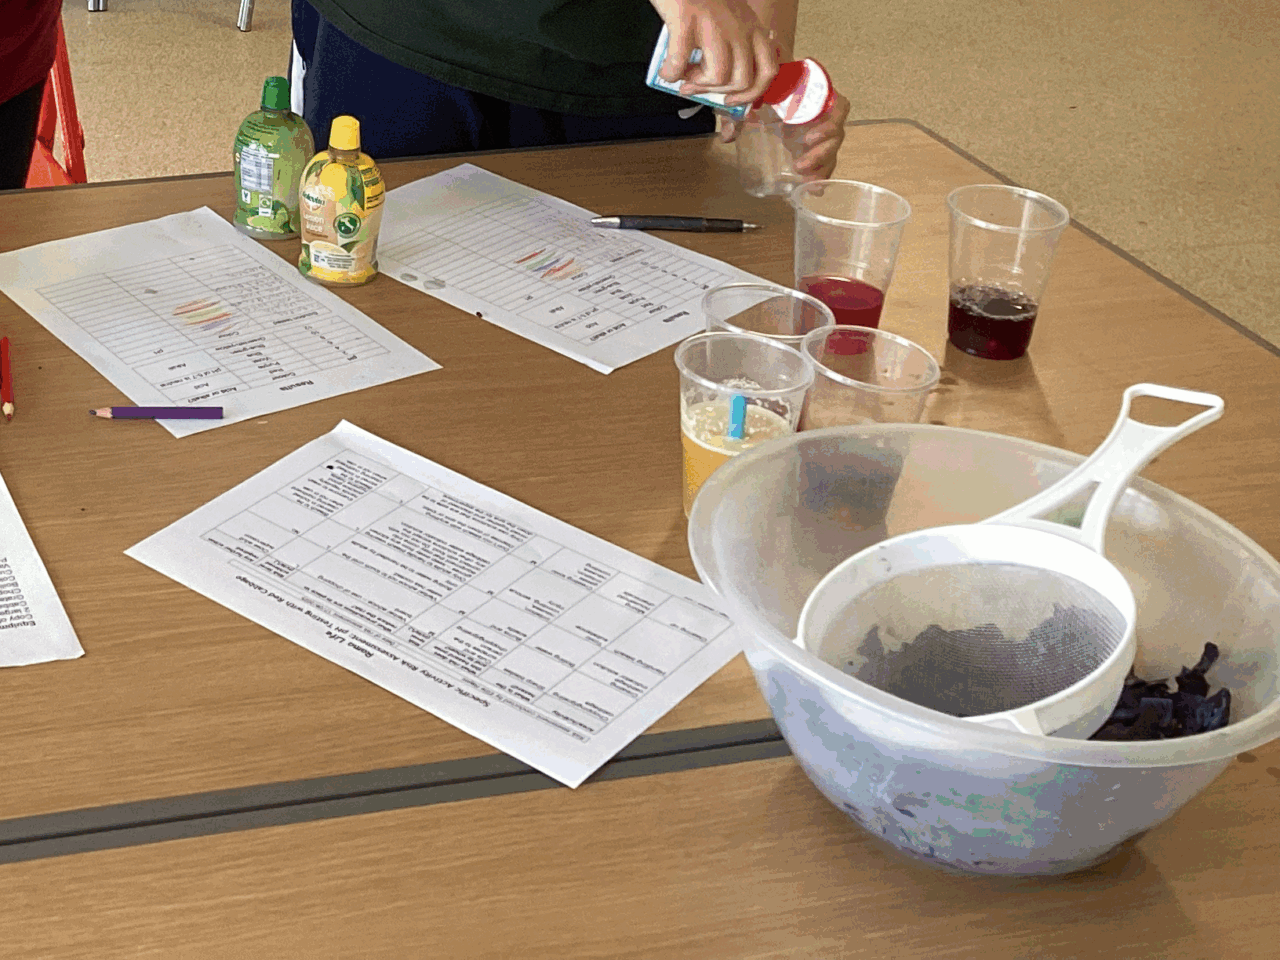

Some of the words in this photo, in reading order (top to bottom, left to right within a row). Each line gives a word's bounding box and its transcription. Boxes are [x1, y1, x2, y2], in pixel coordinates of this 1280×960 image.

[278, 379, 314, 391] Results
[233, 574, 269, 594] Cabbage
[266, 592, 285, 602] Red
[283, 600, 305, 612] with
[7, 612, 33, 621] Copy
[302, 609, 336, 628] Testing
[333, 625, 349, 635] pH
[323, 630, 346, 643] Life
[347, 633, 400, 661] Assessment:
[399, 659, 419, 671] Risk
[419, 669, 454, 689] Activity
[453, 686, 491, 707] Specific
